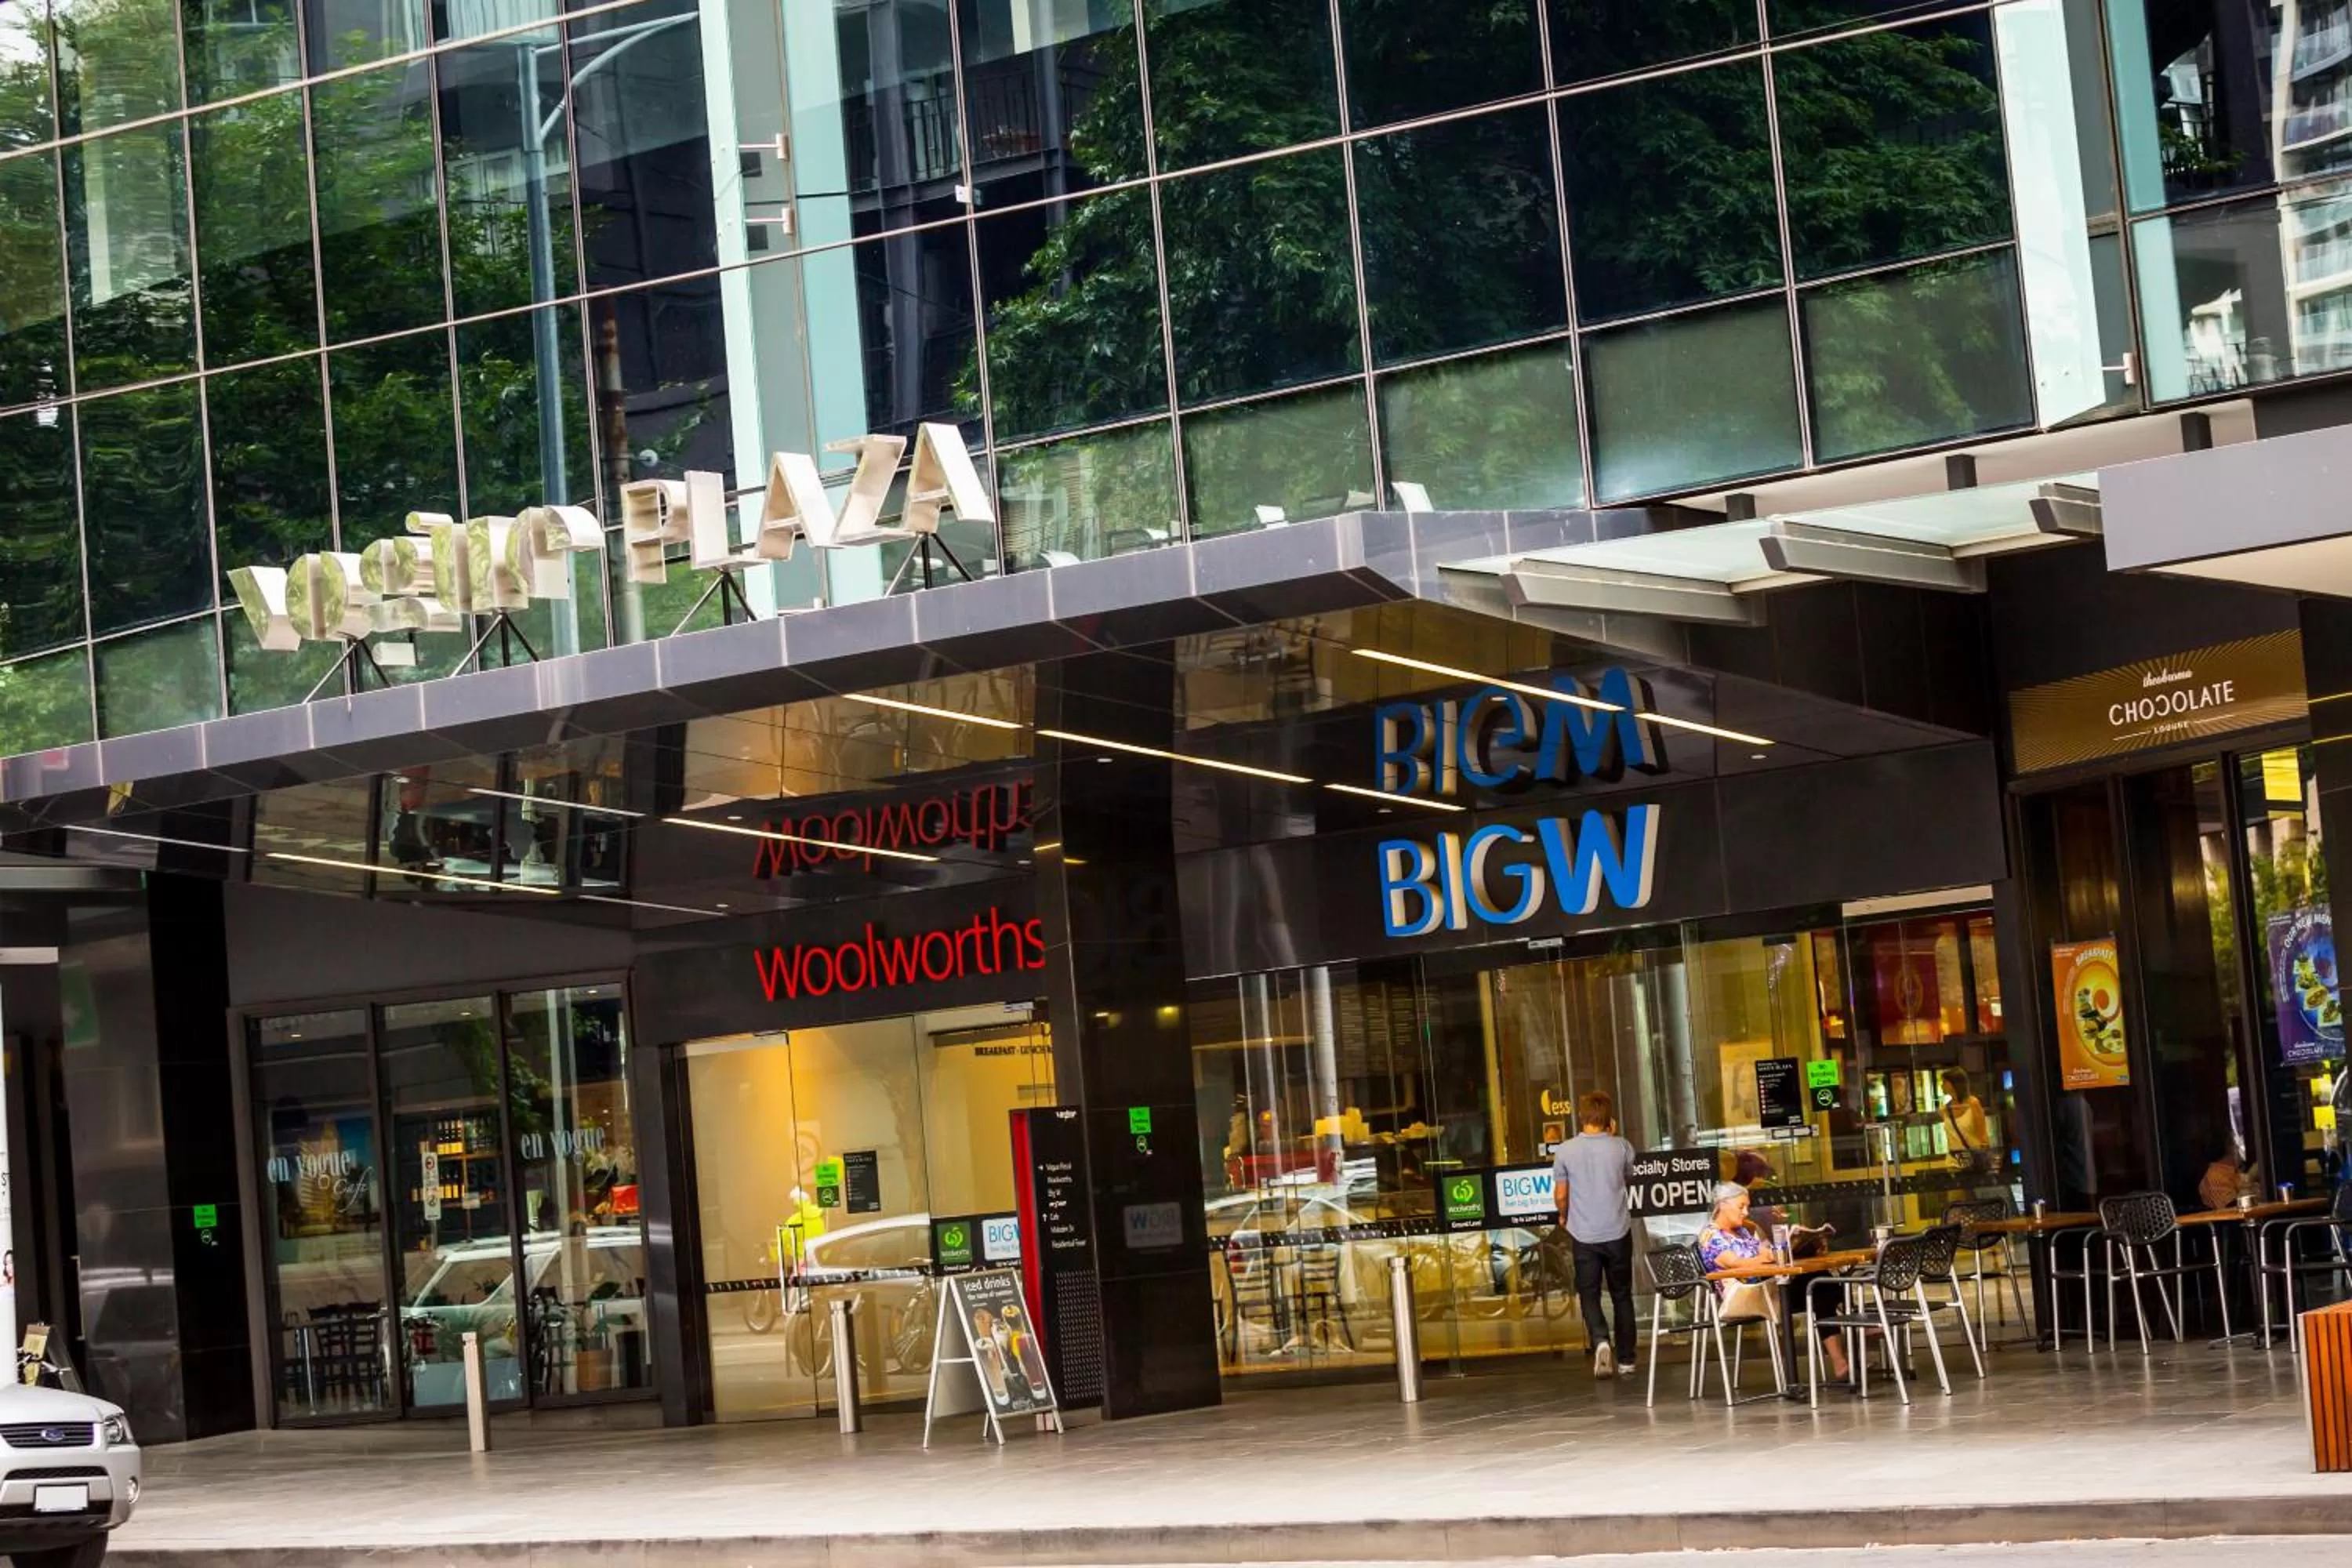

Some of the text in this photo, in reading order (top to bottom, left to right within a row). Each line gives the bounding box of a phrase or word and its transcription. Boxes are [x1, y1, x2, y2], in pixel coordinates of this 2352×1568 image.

[620, 422, 995, 583] PLAZA
[2109, 681, 2235, 726] CHOCOLATE
[2154, 721, 2190, 735] LOUNGE
[2314, 913, 2332, 927] MEN
[521, 1127, 606, 1167] en vogue
[267, 1149, 350, 1189] en vogue
[1632, 1158, 1710, 1177] ecialty Stores
[1650, 1178, 1714, 1207] OPEN
[963, 1276, 1011, 1292] iced drinks
